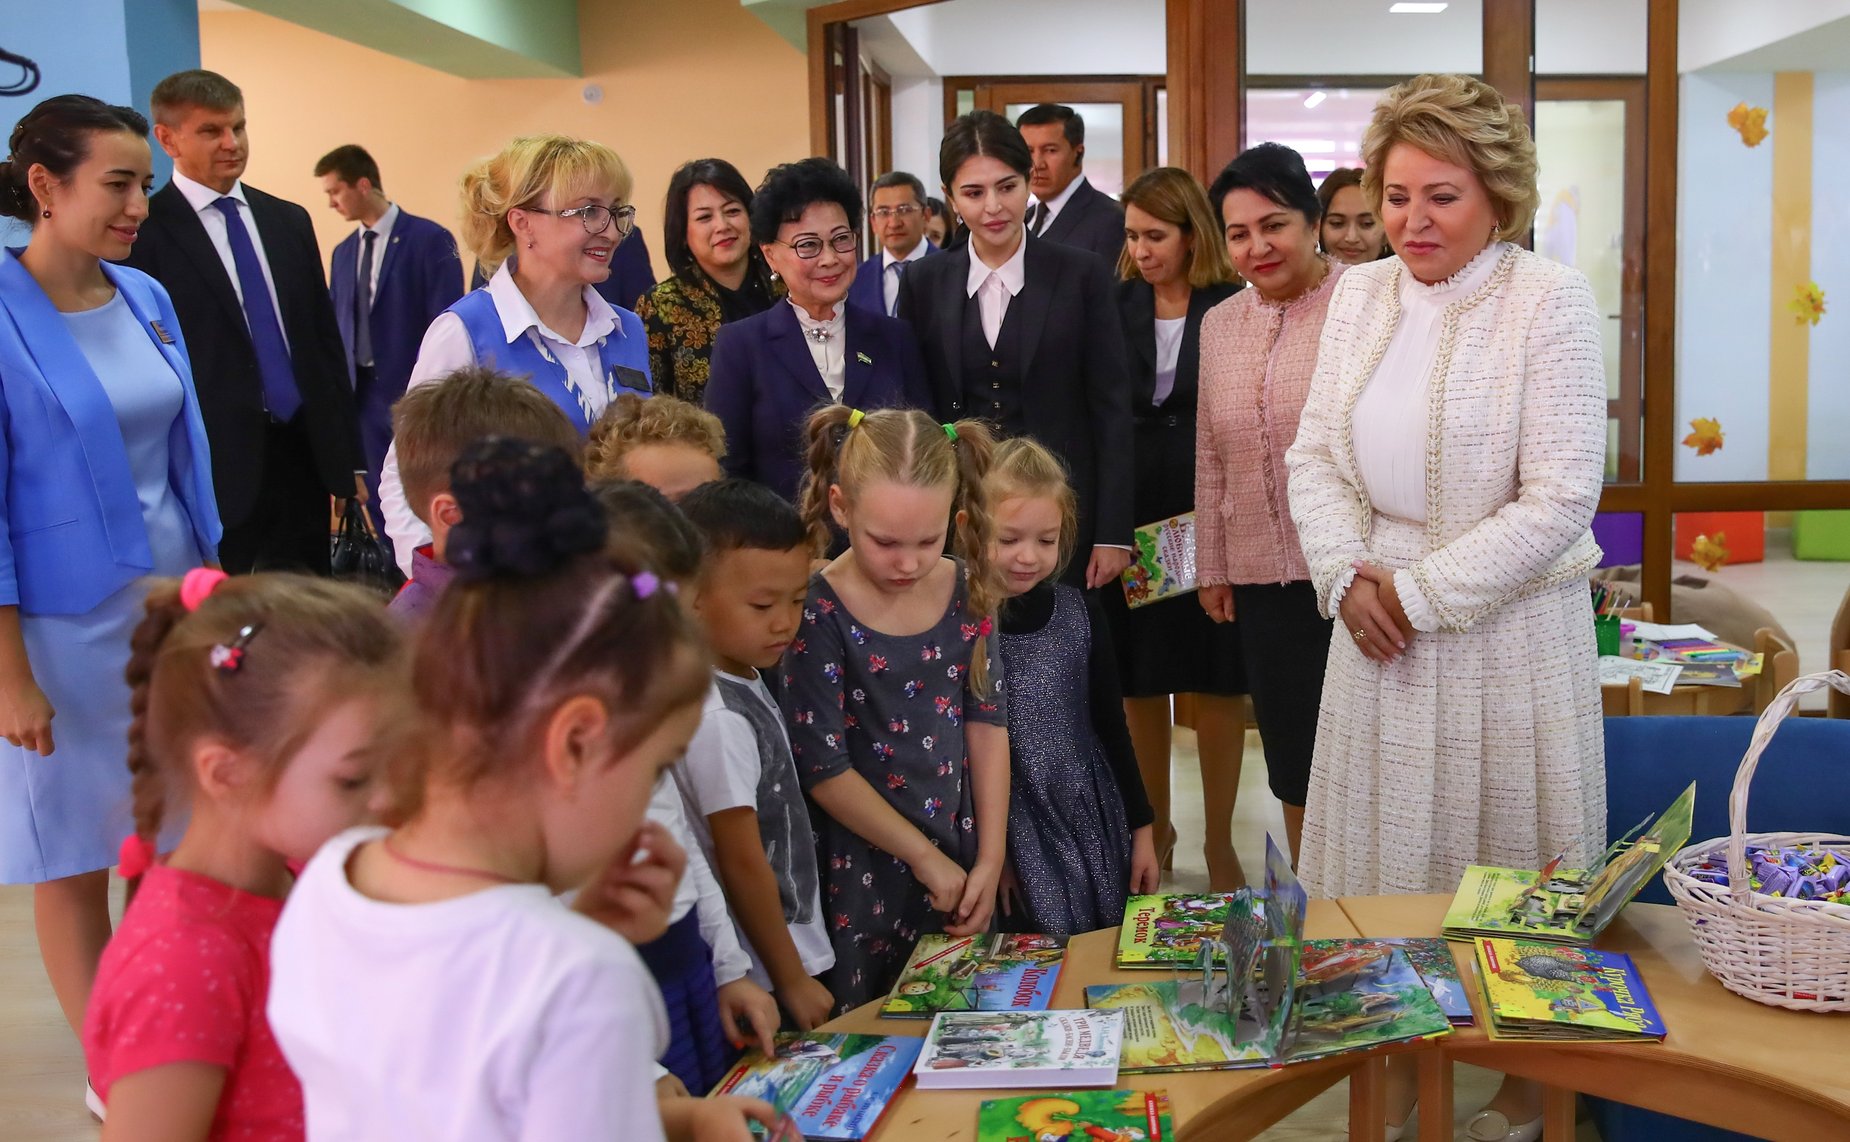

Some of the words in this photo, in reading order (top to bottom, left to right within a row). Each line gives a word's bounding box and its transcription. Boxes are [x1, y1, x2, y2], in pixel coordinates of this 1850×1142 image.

[1133, 907, 1156, 944] Теремок
[1011, 968, 1048, 1007] Колобок
[1599, 966, 1635, 1005] Курочка
[1073, 1017, 1090, 1030] ТРИ
[857, 1045, 897, 1079] Сказка
[1073, 1030, 1092, 1060] МЕДВЕДЯ
[828, 1074, 846, 1083] и
[801, 1083, 838, 1118] рыбке
[822, 1087, 863, 1128] рыбаке
